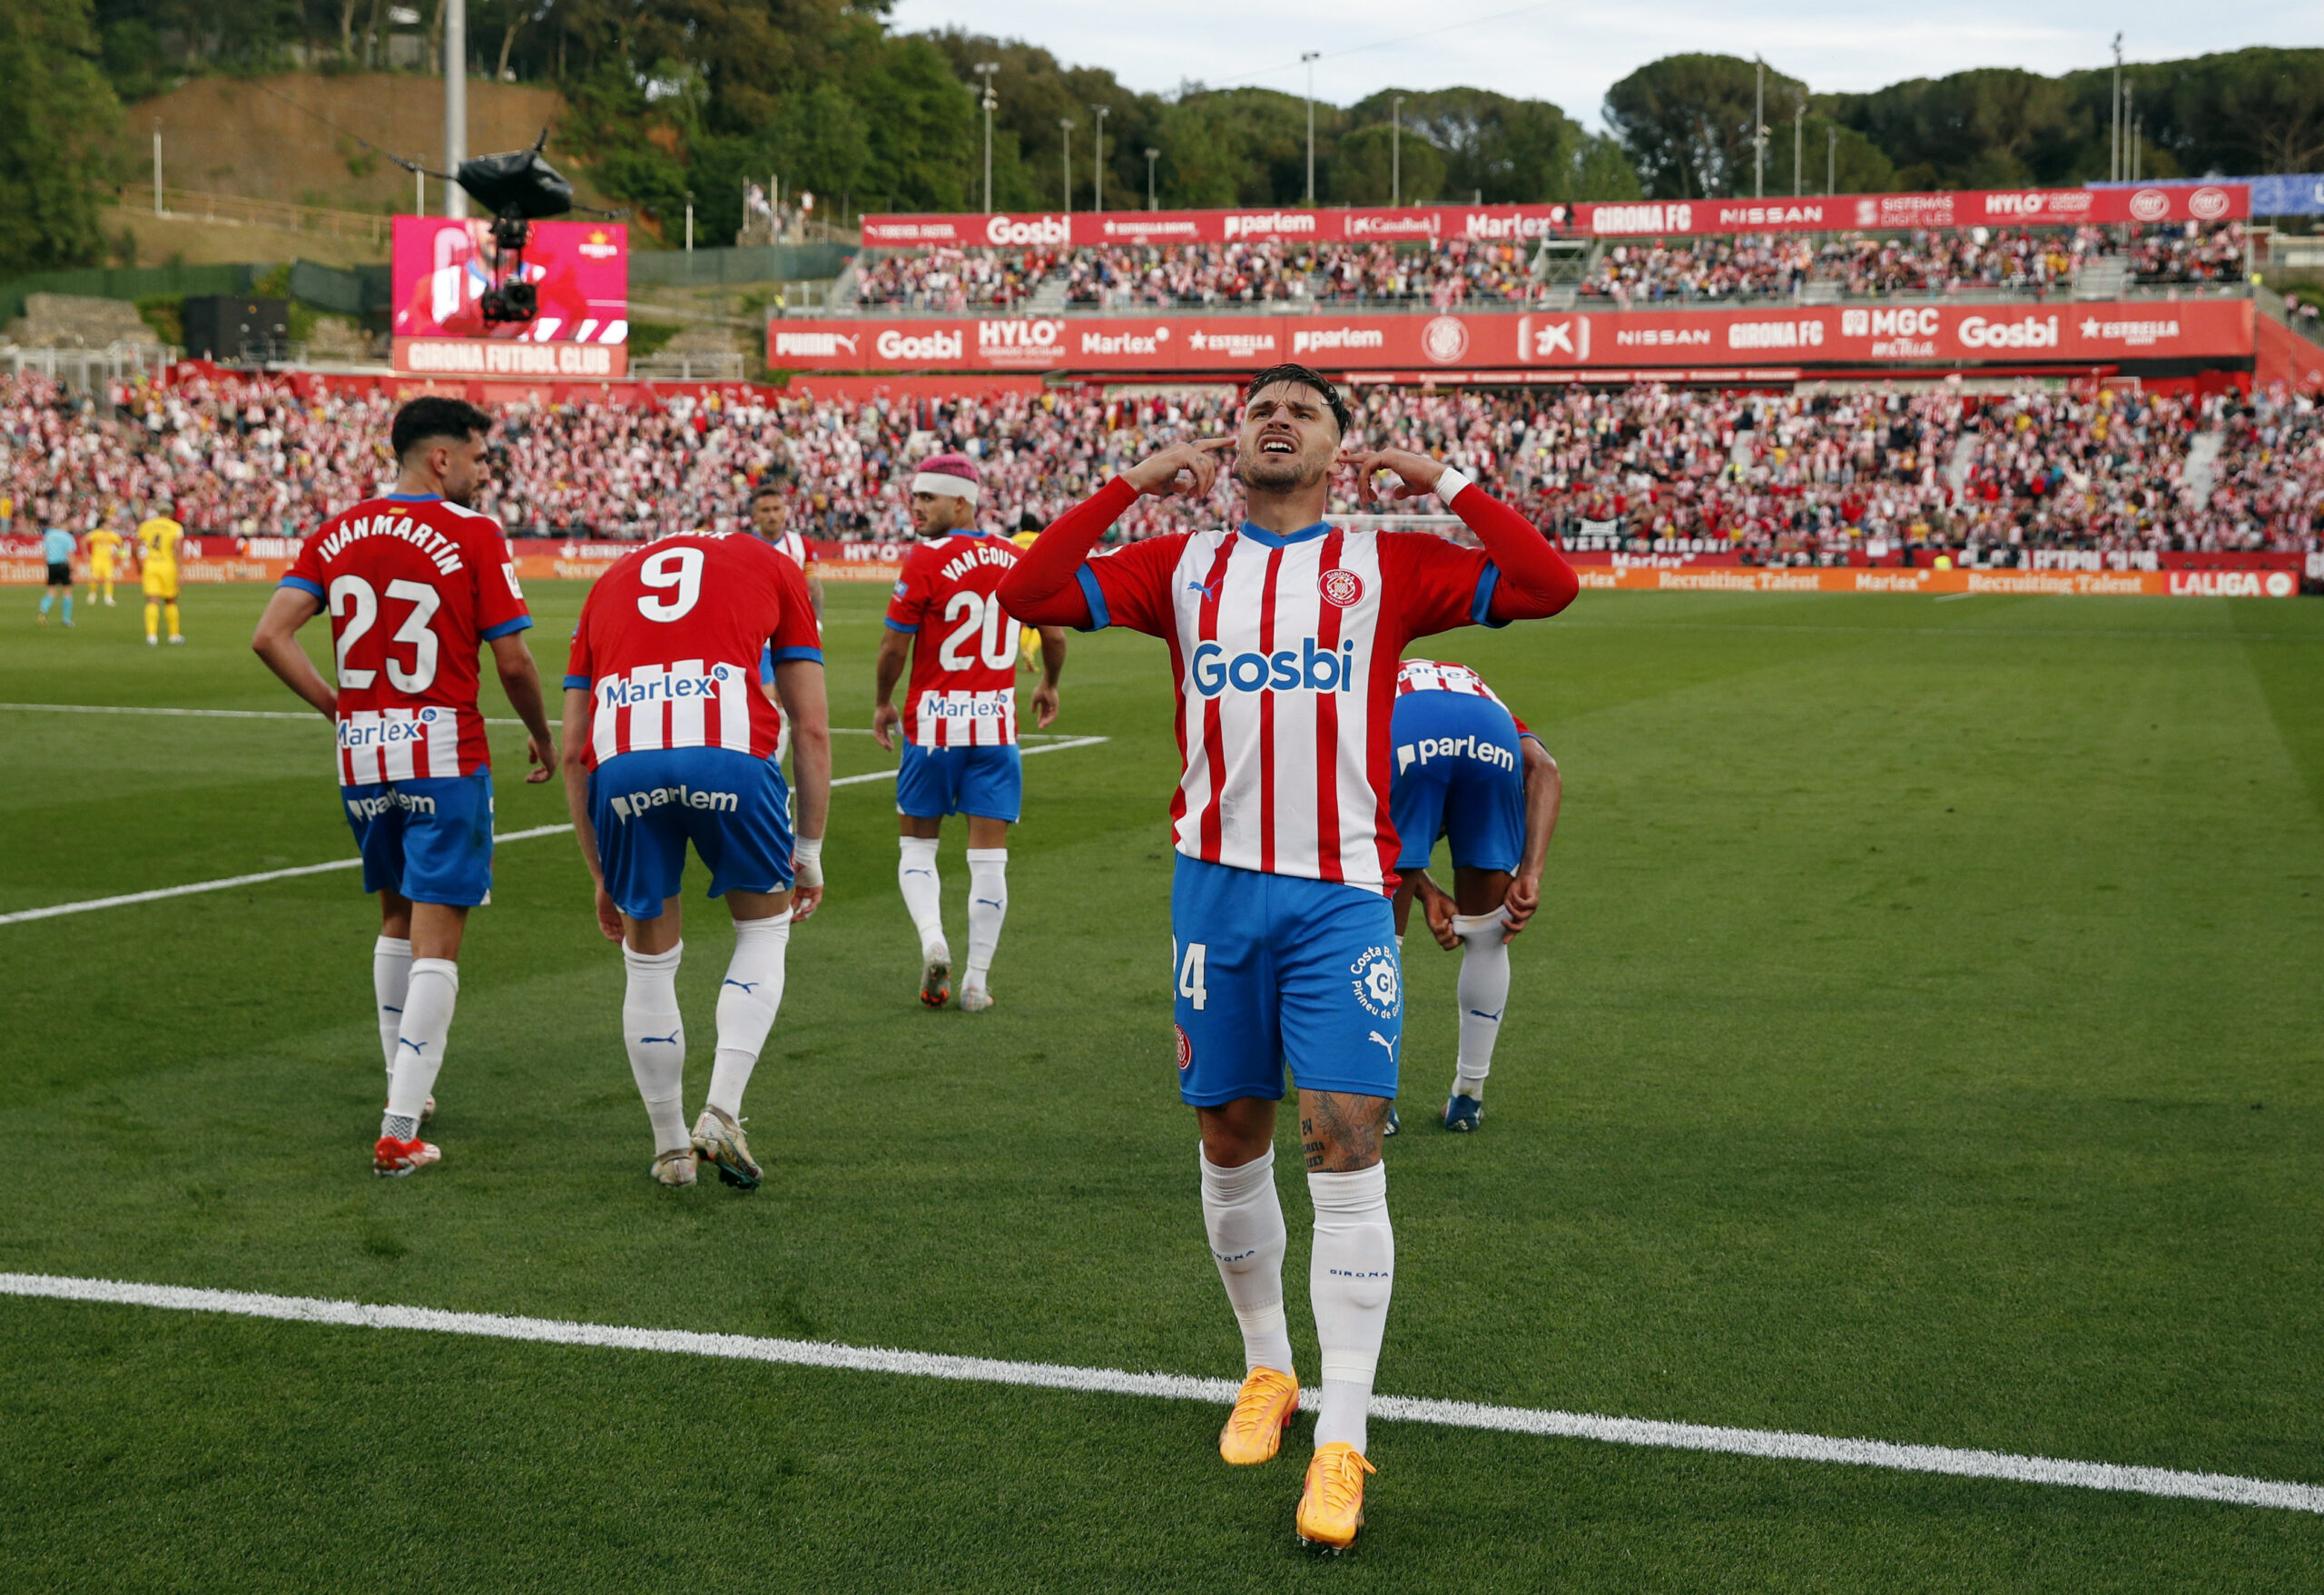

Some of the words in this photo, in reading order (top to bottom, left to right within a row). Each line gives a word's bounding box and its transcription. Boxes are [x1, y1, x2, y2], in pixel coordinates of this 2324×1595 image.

[1720, 206, 1822, 225] NISSAN
[1985, 193, 2043, 213] HYLO
[986, 215, 1071, 245] Gosbi
[1240, 211, 1315, 238] parlem
[1466, 212, 1551, 237] Marlex
[1592, 205, 1664, 233] GIRONA
[1665, 204, 1691, 231] FC
[978, 320, 1058, 347] HYLO
[1728, 322, 1797, 349] GIRONA
[1798, 320, 1824, 347] FC
[1871, 308, 1939, 336] MGC
[1958, 316, 2059, 348] Gosbi
[2102, 320, 2180, 339] ESTRELLA
[876, 329, 963, 359] Gosbi
[1081, 331, 1157, 355] Marlex
[1207, 334, 1275, 351] ESTRELLA
[1309, 327, 1384, 353] parlem
[1617, 330, 1711, 346] NISSAN
[409, 342, 485, 371] GIRONA
[558, 346, 611, 375] CLUB
[318, 517, 369, 563] IVÁN
[370, 514, 464, 576] MARTÍN
[940, 549, 979, 582] VAN
[977, 546, 1019, 570] COUT
[1326, 571, 1355, 581] GIRONA
[636, 546, 704, 623] 9
[1659, 570, 1757, 592] Recruiting
[1757, 572, 1820, 590] Talent
[1855, 572, 1919, 591] Marlex
[1967, 573, 2076, 595] Recruiting
[2075, 574, 2142, 593] Talent
[2169, 572, 2262, 596] LALIGA
[329, 574, 441, 694] 23
[938, 589, 1022, 672] 20
[1192, 636, 1354, 697] Gosbi
[606, 674, 714, 709] Marlex
[927, 698, 1001, 717] Marlex
[337, 722, 421, 748] Marlex
[1418, 734, 1514, 773] parlem
[359, 788, 436, 822] parlem
[629, 784, 739, 818] parlem
[1172, 933, 1207, 1011] 4
[1350, 946, 1382, 975] Costa
[1376, 973, 1393, 995] G!
[1351, 980, 1379, 1016] Pirineu
[1381, 1009, 1392, 1019] de
[1301, 1117, 1313, 1136] 24
[1330, 1268, 1389, 1278] GIRONA
